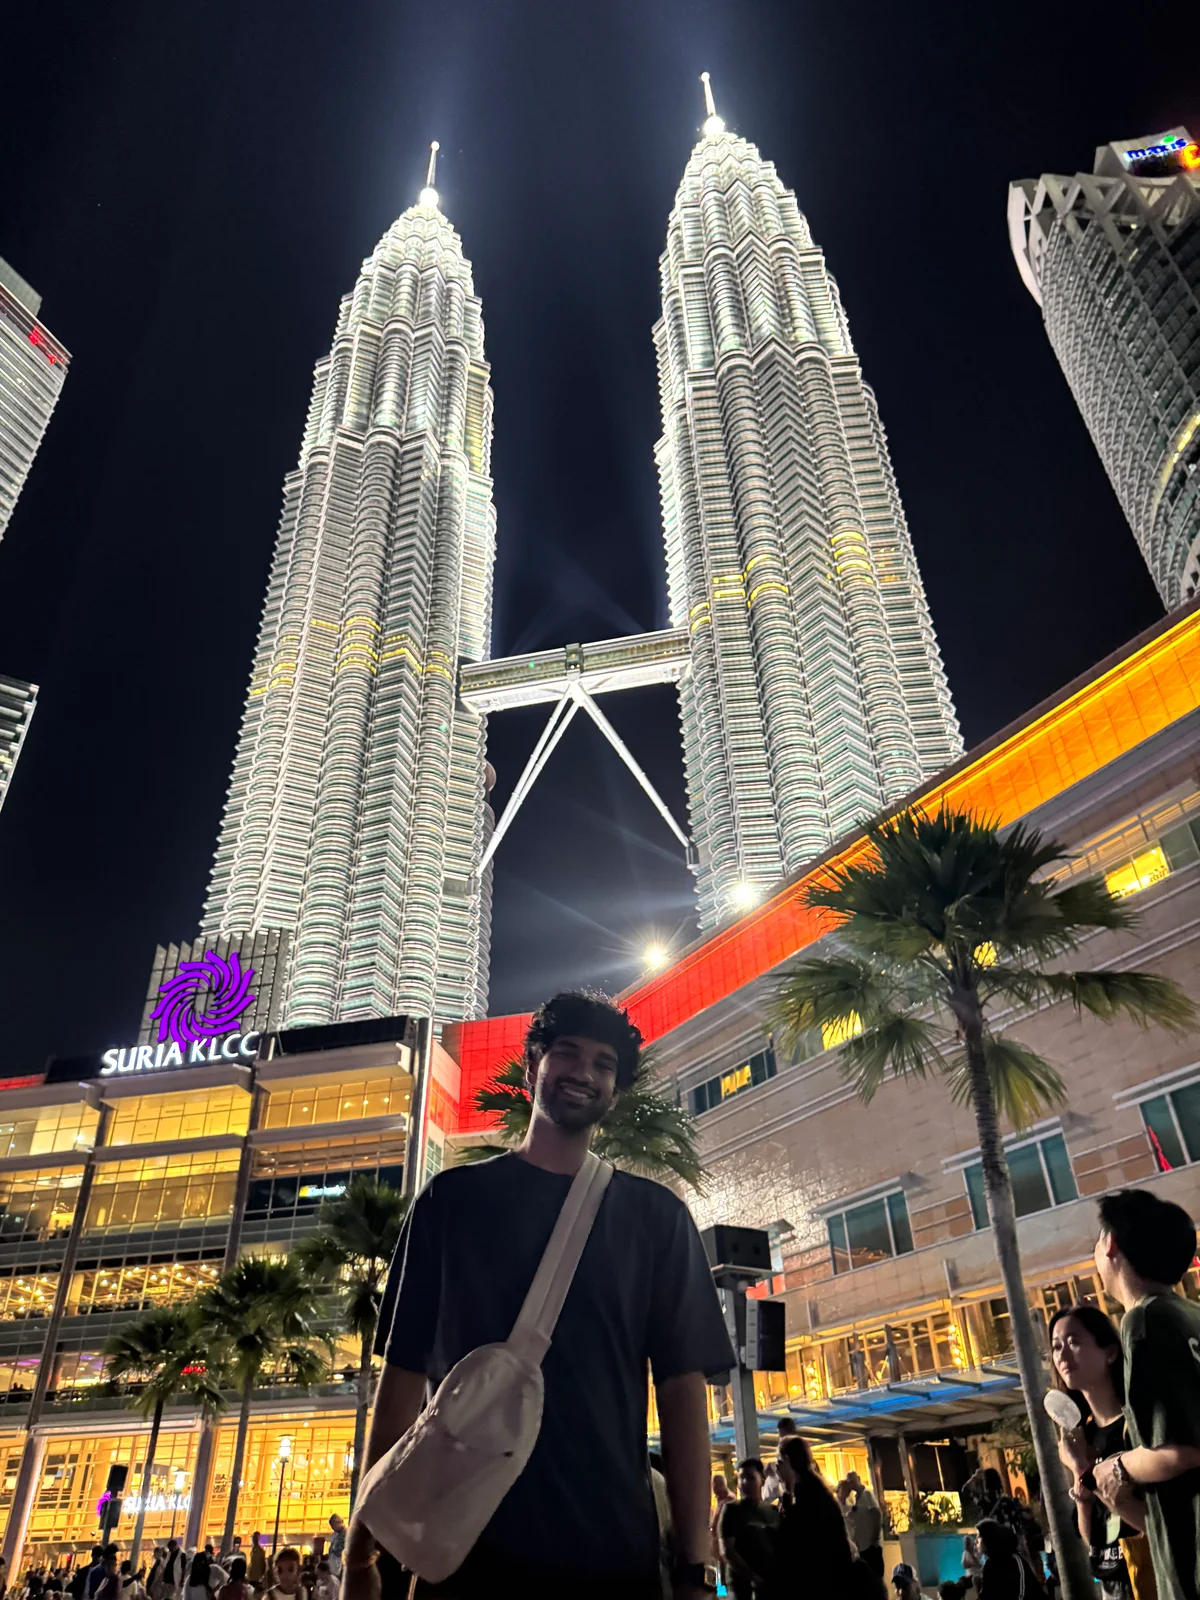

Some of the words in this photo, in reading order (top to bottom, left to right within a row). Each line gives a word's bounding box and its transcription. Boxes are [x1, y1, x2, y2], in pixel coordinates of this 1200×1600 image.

[1125, 135, 1187, 161] maxis
[101, 1042, 183, 1074] SURIA
[191, 1031, 259, 1062] KLCC
